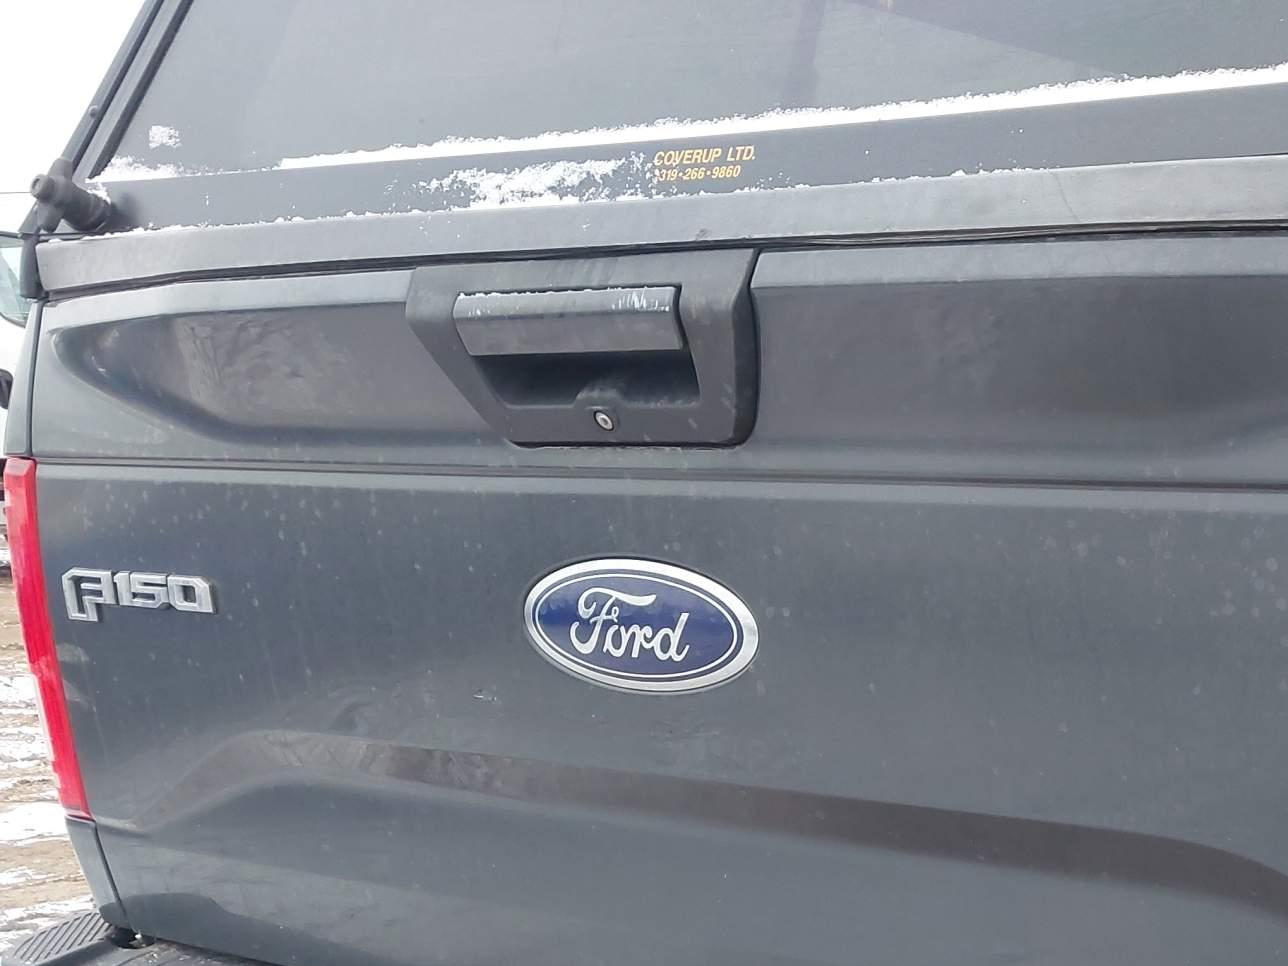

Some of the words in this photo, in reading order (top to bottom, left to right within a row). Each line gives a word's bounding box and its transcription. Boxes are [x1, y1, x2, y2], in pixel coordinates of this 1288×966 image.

[653, 147, 722, 167] COVERUP
[726, 144, 756, 162] LTD.
[569, 587, 691, 662] Ford
